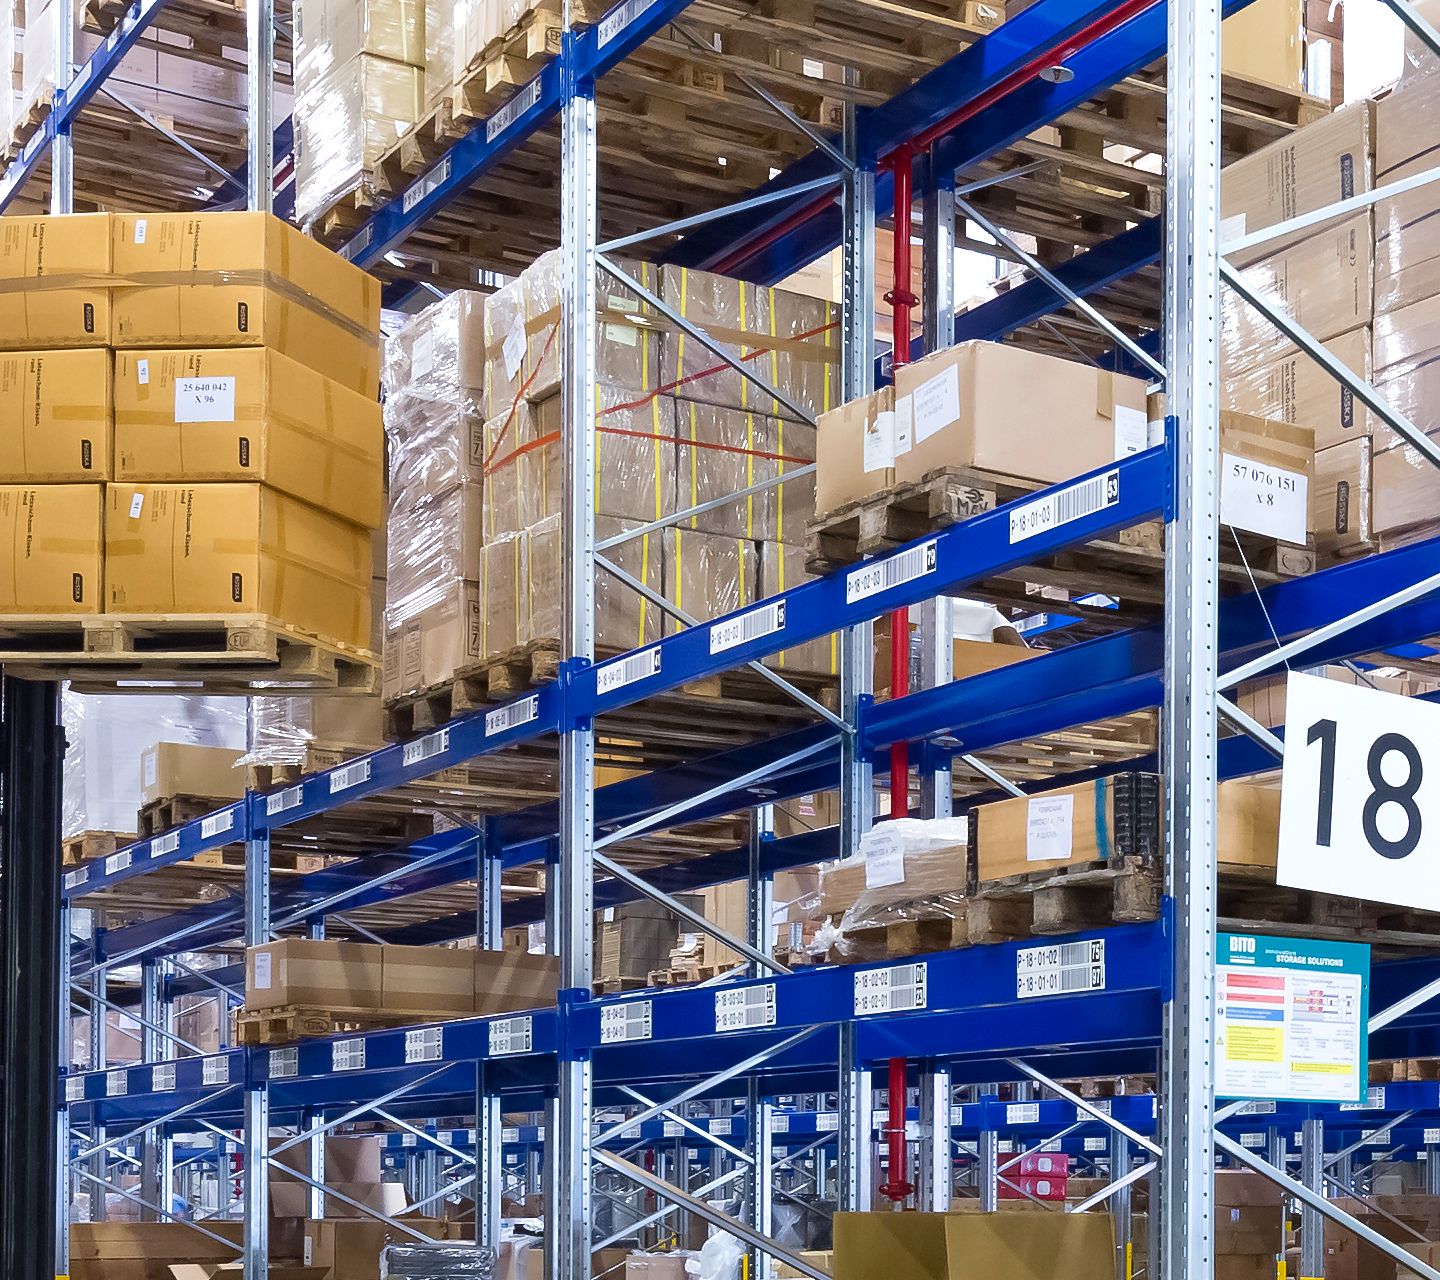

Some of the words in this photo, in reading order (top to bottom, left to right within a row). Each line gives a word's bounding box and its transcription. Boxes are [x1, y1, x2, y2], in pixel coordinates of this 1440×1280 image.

[183, 384, 195, 392] 25
[196, 384, 211, 392] 640
[212, 384, 227, 392] 042
[203, 395, 215, 403] 96
[1233, 464, 1248, 478] 57
[1252, 468, 1274, 485] 076
[1277, 476, 1296, 492] 151
[1011, 507, 1051, 535] P-18-01-03
[1108, 476, 1118, 496] 53
[1256, 495, 1263, 504] x
[1266, 493, 1274, 506] 8
[1338, 485, 1347, 534] RUSSKA
[848, 570, 881, 592] P-18-02-03
[927, 549, 936, 566] 79
[1305, 718, 1423, 860] 18
[1230, 935, 1256, 953] BITO
[1018, 949, 1057, 968] P-18-01-02
[1091, 942, 1101, 961] 75
[1276, 954, 1307, 963] STORAGE
[1308, 956, 1344, 967] SOLUTIONS
[855, 971, 888, 988] P-18-02-02
[1018, 974, 1058, 991] P-18-01-01
[1091, 967, 1101, 986] 97
[855, 994, 888, 1009] P-18-02-01
